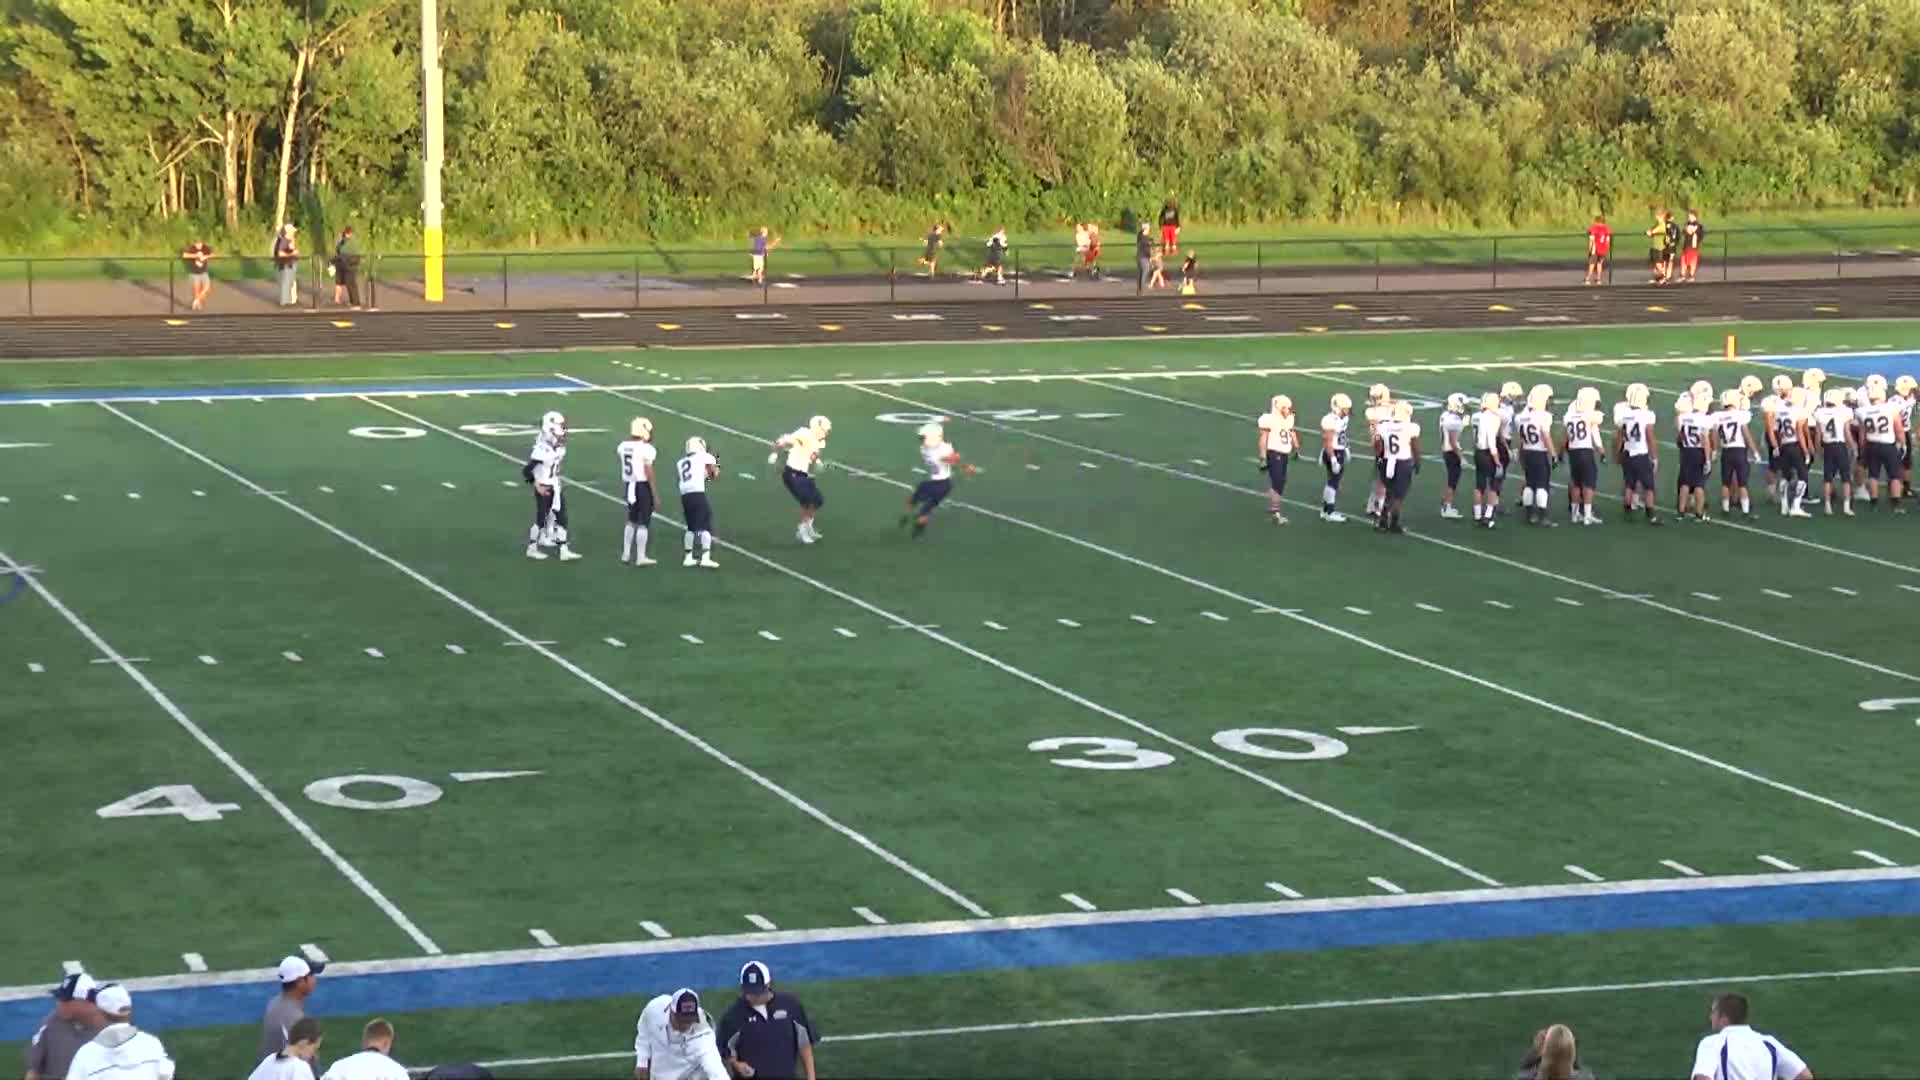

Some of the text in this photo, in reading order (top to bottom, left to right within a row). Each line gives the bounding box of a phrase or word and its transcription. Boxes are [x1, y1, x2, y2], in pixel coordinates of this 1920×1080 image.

[1825, 418, 1837, 439] 4
[1388, 434, 1400, 455] 6
[624, 455, 633, 476] 5
[680, 460, 692, 482] 2
